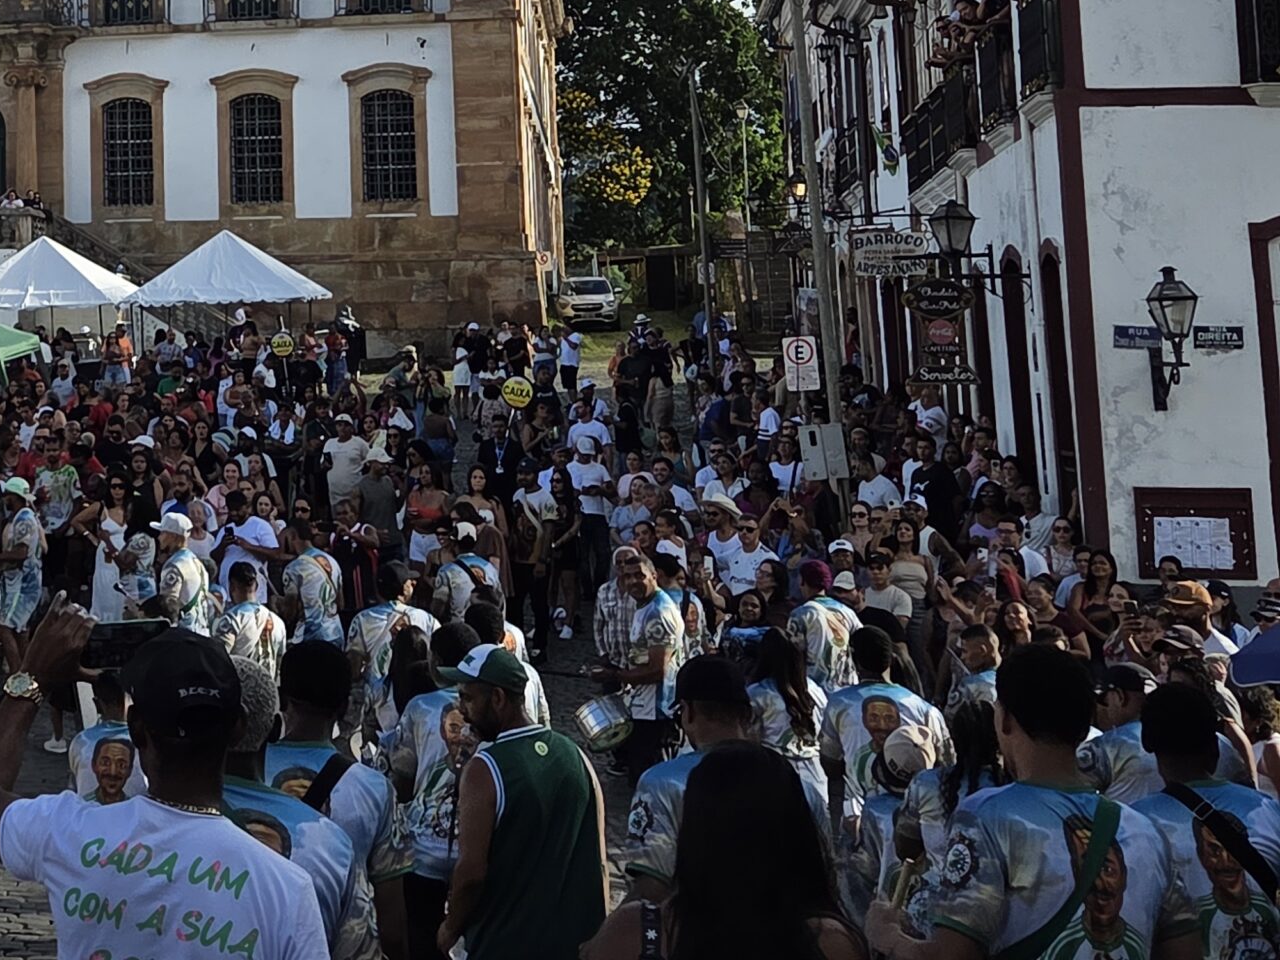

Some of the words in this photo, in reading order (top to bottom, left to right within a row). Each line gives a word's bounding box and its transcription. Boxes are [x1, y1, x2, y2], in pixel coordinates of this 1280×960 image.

[855, 233, 924, 250] BARROCO
[856, 259, 926, 275] ARTESANATO
[1128, 328, 1150, 336] RUA
[1198, 332, 1239, 341] DIREITA
[795, 345, 805, 360] E
[920, 367, 975, 381] Sorvetes
[503, 385, 531, 399] CAIXA
[80, 838, 179, 883] CADA
[188, 855, 250, 900] UM
[63, 887, 128, 930] COM
[136, 904, 167, 936] A
[175, 910, 259, 960] SUA
